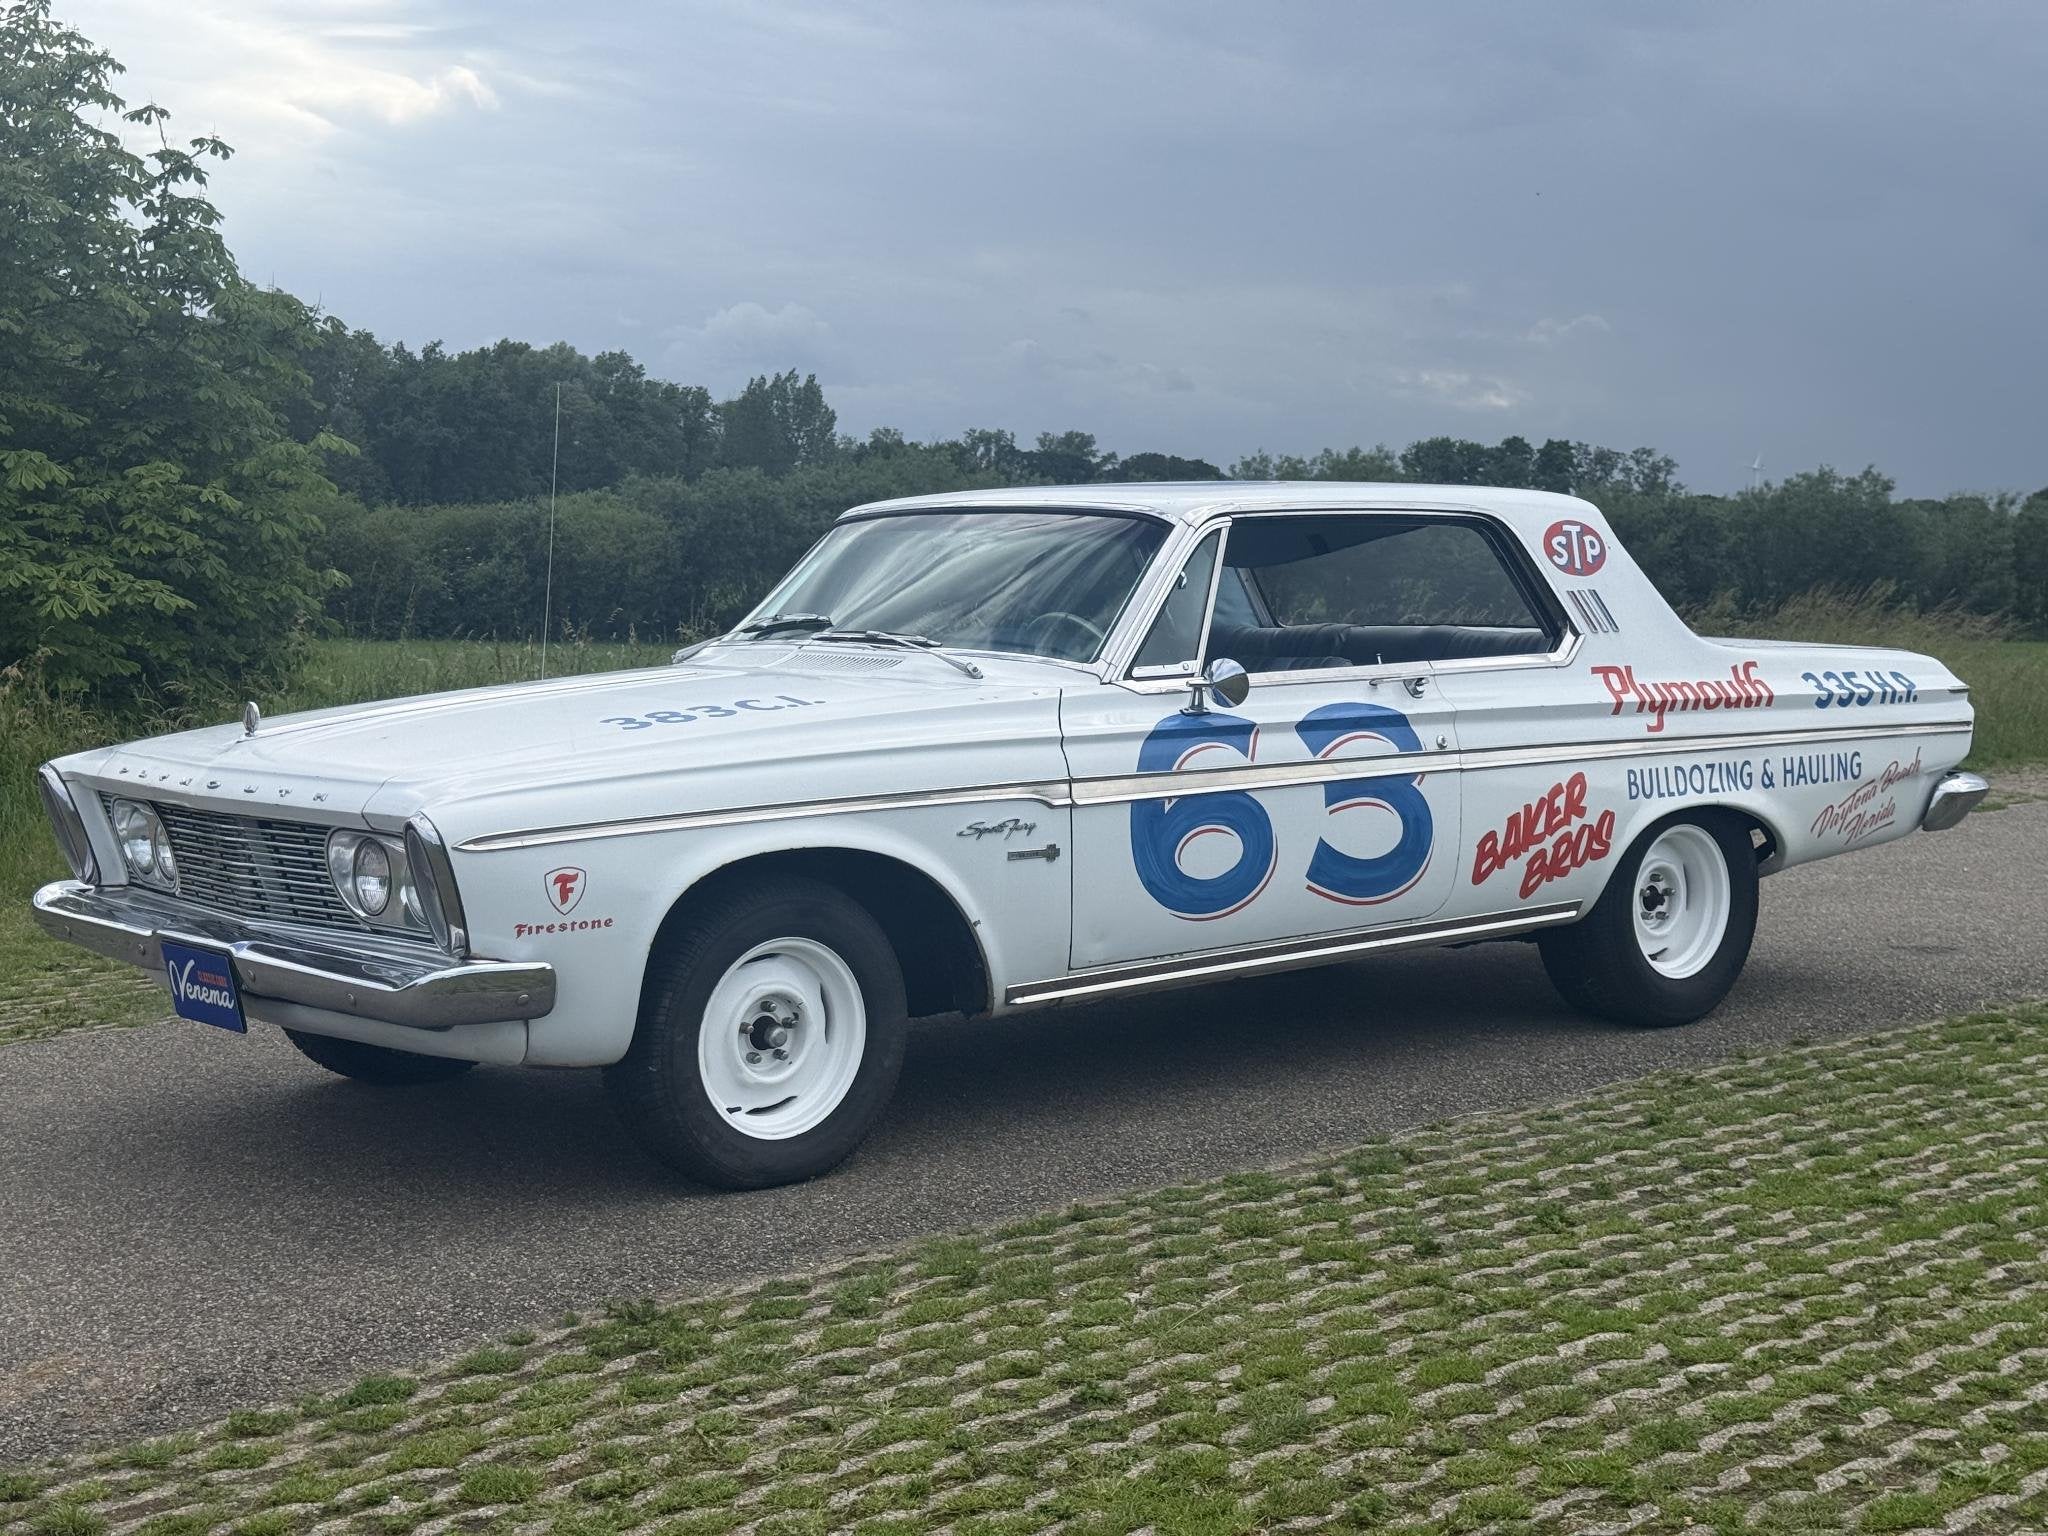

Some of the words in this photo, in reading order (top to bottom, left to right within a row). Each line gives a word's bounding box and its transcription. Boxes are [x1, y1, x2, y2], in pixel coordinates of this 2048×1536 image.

[1551, 525, 1601, 569] STP
[1591, 661, 1775, 733] Plymouth
[1627, 759, 1753, 800] BULLDOZING
[1761, 758, 1775, 789] &
[1783, 751, 1862, 787] HAULING
[1880, 746, 1921, 793] Beach
[1130, 702, 1434, 918] 63
[1472, 772, 1588, 886] BAKER
[1844, 796, 1896, 845] Florida
[1519, 810, 1616, 900] BROS
[514, 917, 614, 939] Firestone
[169, 959, 234, 1009] Venema
